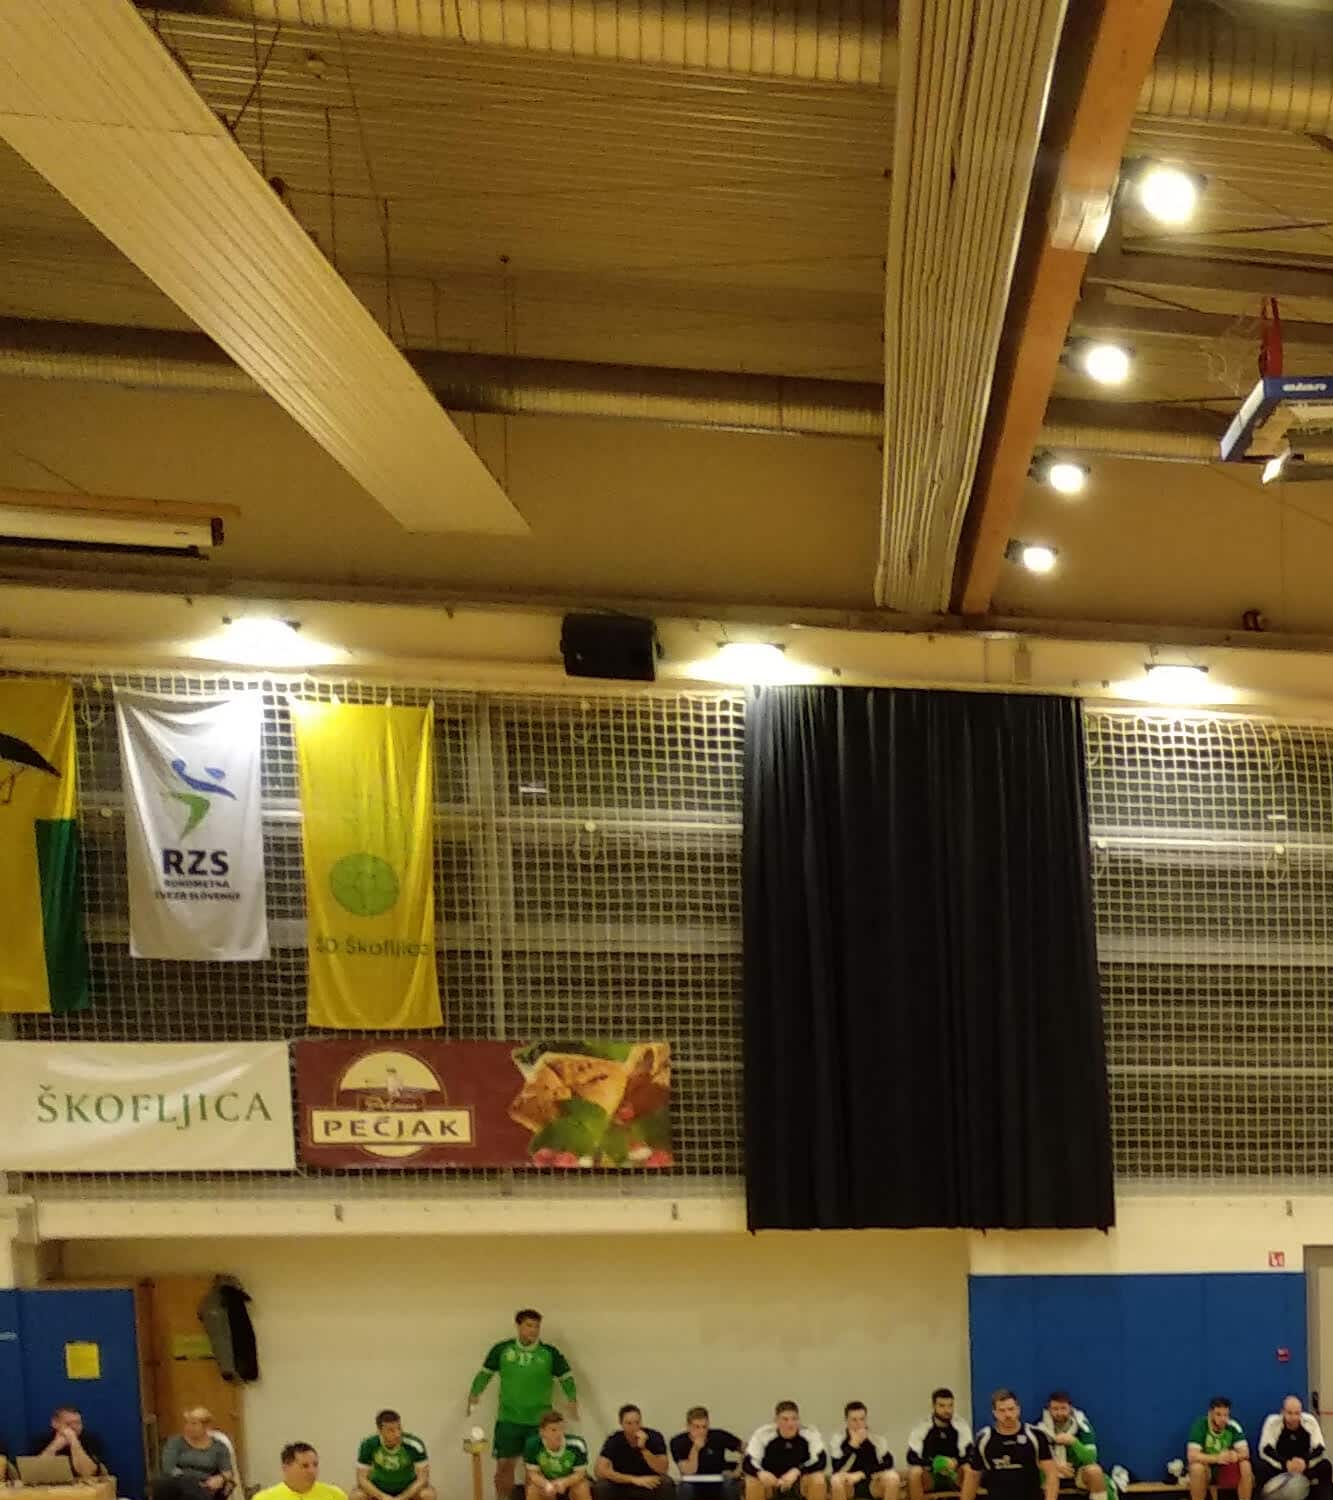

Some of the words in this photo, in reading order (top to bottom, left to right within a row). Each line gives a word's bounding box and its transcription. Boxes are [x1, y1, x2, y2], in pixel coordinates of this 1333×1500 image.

[162, 848, 230, 877] RZS
[36, 1084, 273, 1131] ŠKOFLJICA
[322, 1115, 461, 1138] PEČJAK
